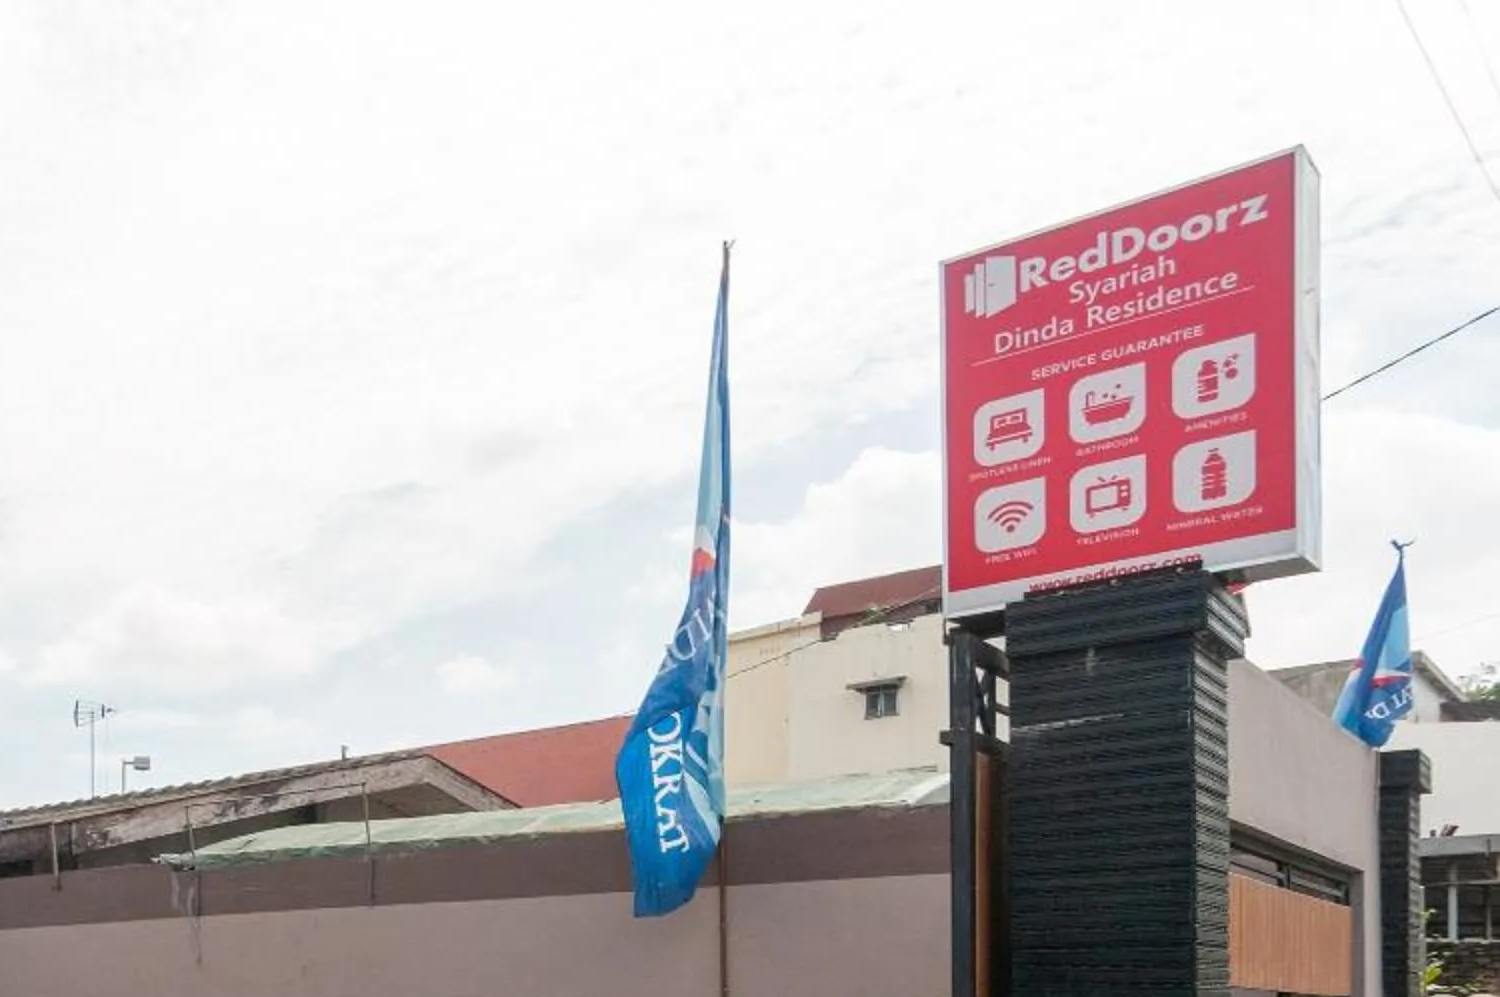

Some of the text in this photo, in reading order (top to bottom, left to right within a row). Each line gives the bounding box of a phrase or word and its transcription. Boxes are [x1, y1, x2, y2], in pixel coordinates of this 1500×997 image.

[1020, 194, 1269, 292] RedDoorz
[1069, 254, 1177, 305] Syariah
[994, 270, 1238, 354] Dinda Residence
[1031, 324, 1206, 381] SERVICE GUARANTEE
[1075, 435, 1140, 457] BATHROOM
